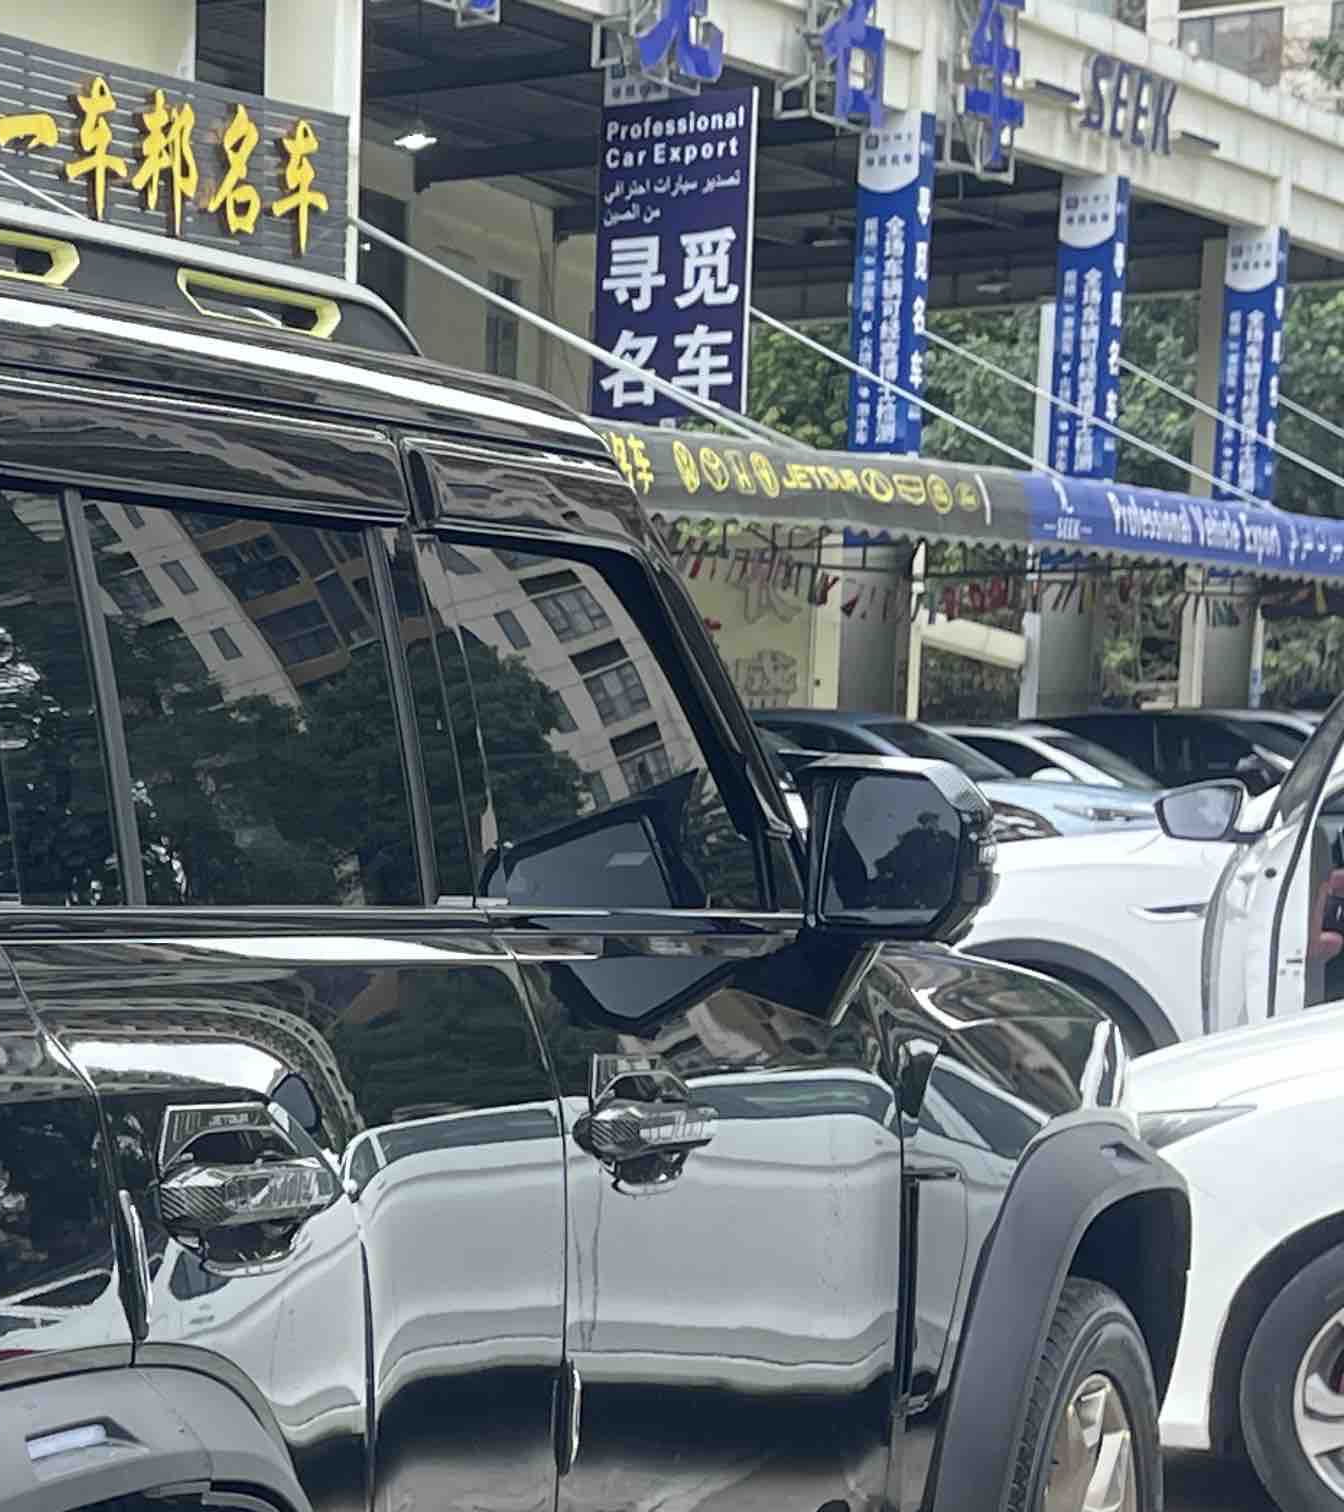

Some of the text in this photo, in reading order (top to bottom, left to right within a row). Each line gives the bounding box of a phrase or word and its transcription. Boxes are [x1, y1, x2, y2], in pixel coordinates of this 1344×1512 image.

[606, 105, 745, 142] Professional
[1079, 53, 1178, 156] SEEK
[605, 136, 739, 169] Car Export
[602, 226, 740, 313] 寻觅
[600, 323, 734, 409] 名车
